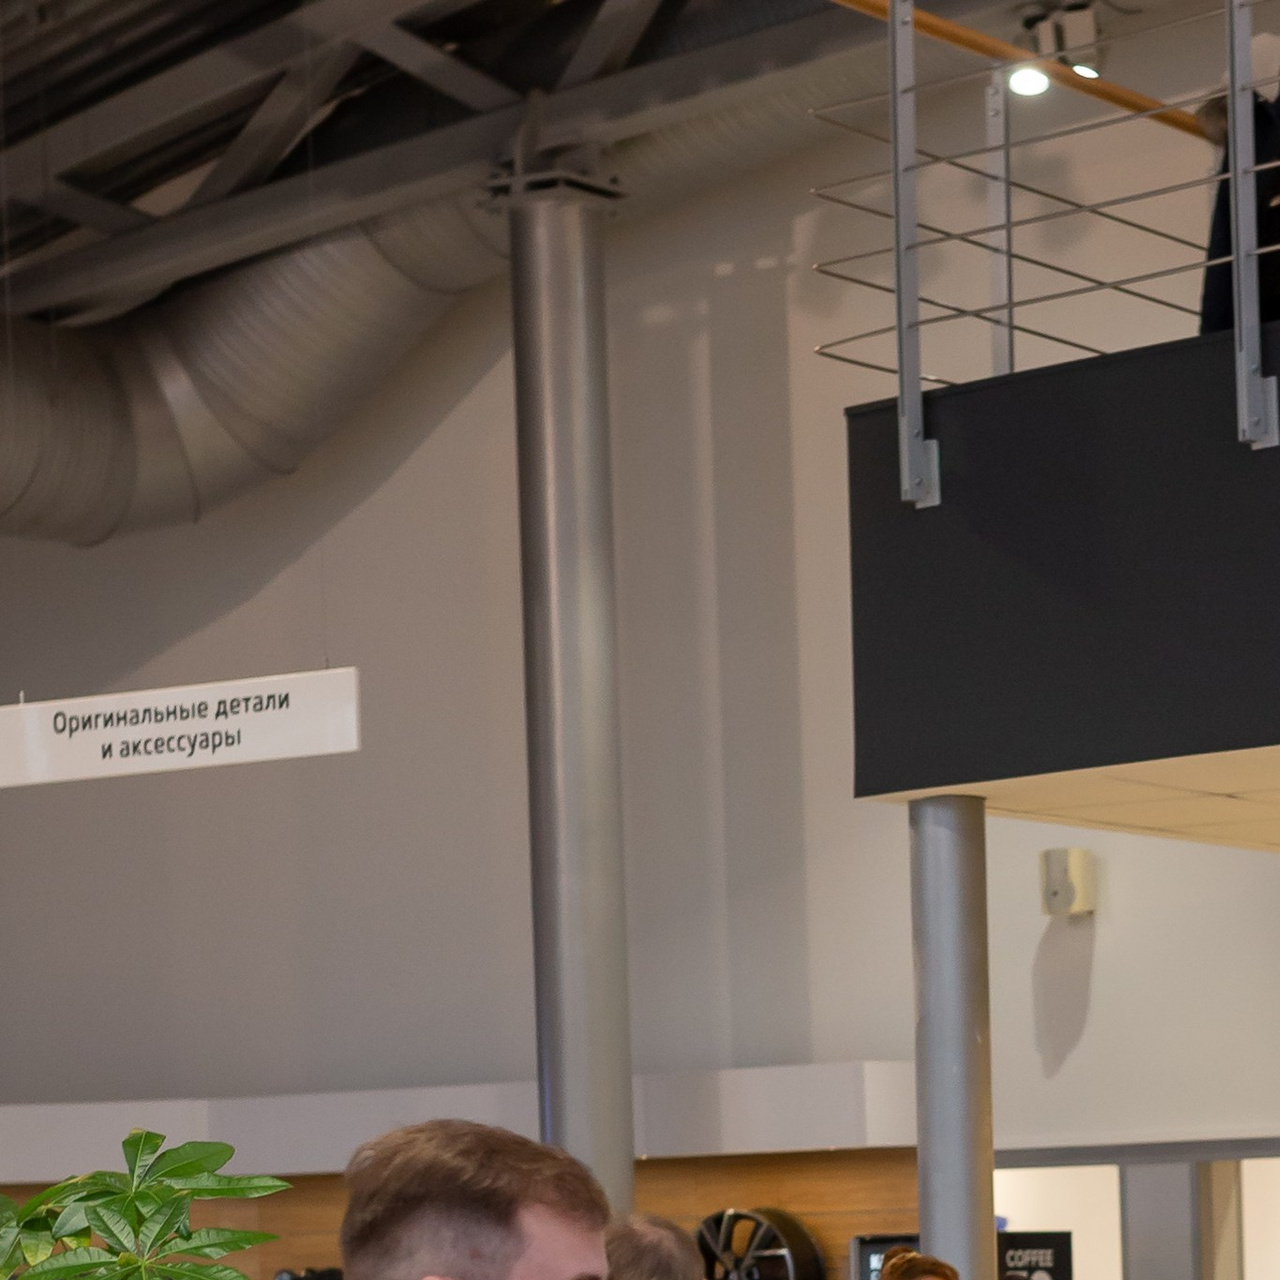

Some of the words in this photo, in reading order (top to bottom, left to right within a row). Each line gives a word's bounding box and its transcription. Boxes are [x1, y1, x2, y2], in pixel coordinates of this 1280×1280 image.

[53, 699, 208, 738] Оригинальные
[215, 691, 290, 719] детали
[101, 741, 113, 759] и
[119, 728, 242, 758] аксессуары
[1005, 1249, 1054, 1268] COFFEE
